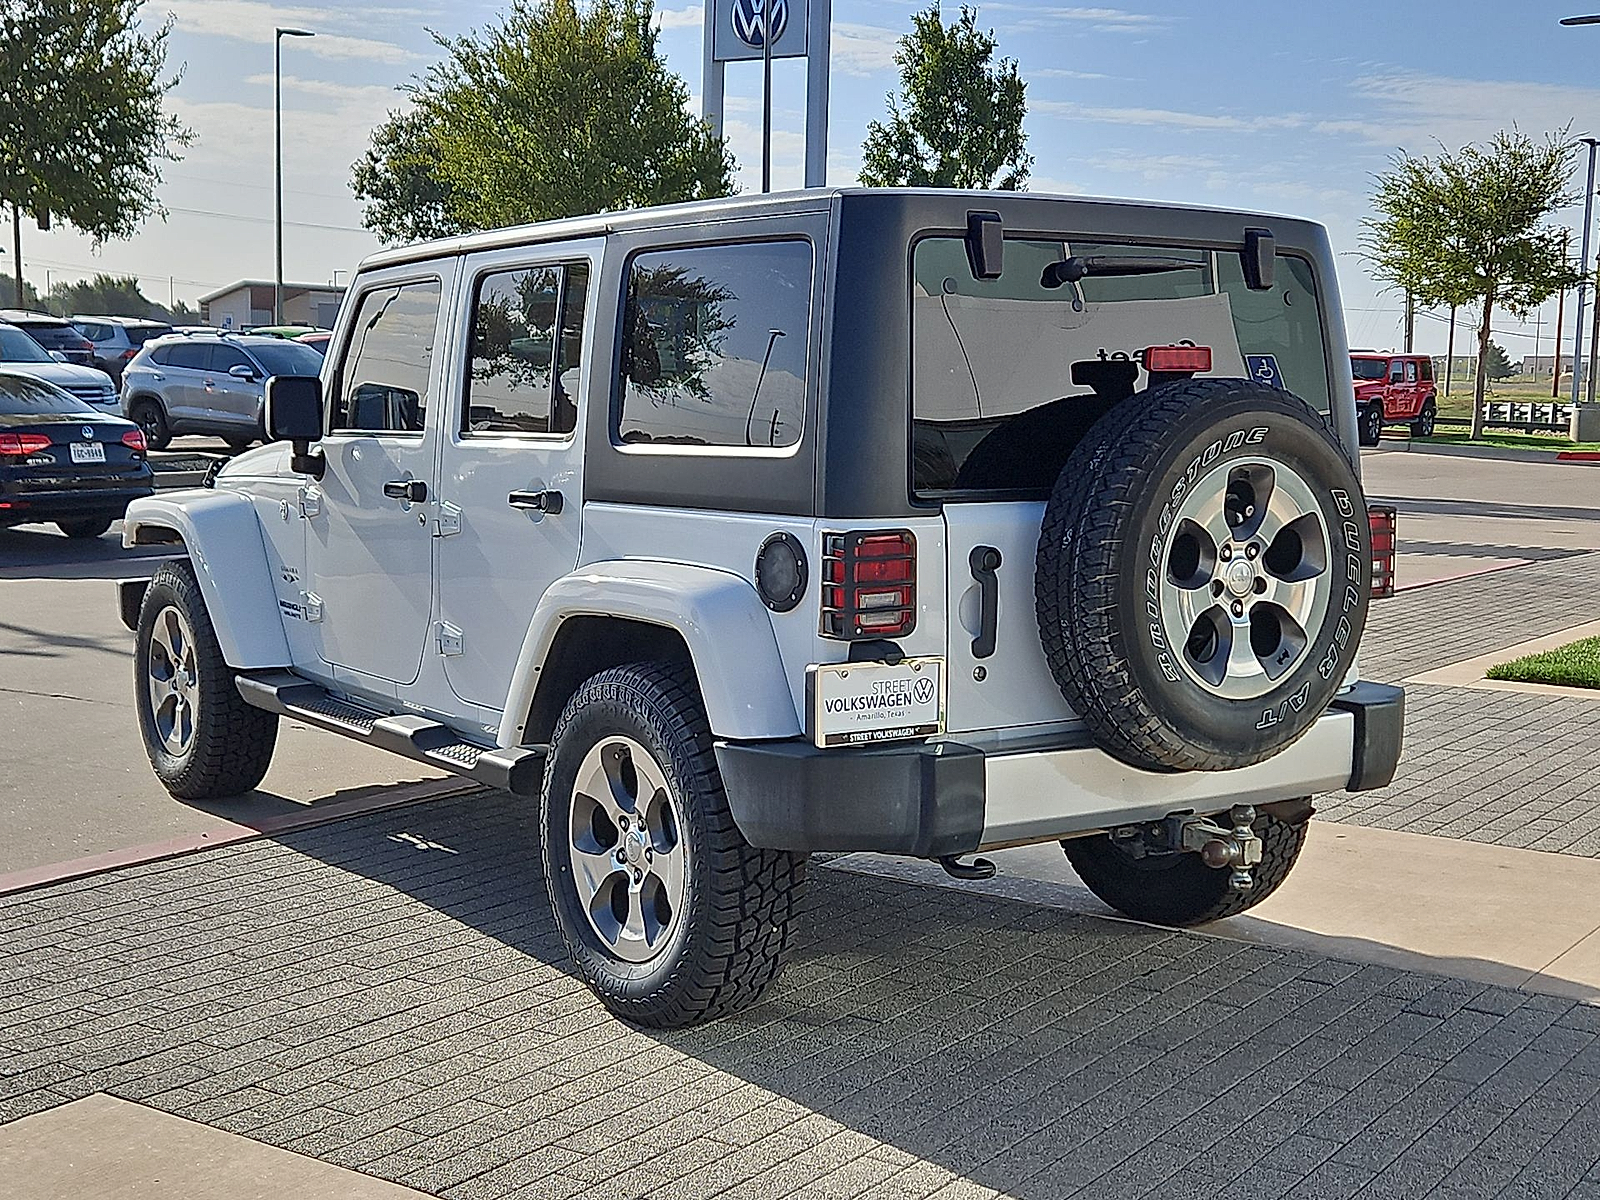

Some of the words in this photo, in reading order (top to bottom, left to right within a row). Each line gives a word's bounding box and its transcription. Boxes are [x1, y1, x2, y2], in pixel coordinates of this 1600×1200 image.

[1146, 427, 1269, 682] BRIDGESTONE
[1317, 488, 1362, 680] DUELER
[872, 679, 912, 695] STREET
[825, 692, 912, 713] VOLKSWAGEN
[1255, 682, 1310, 730] A/T
[856, 712, 886, 721] Amarillo,
[887, 710, 905, 719] Texas
[849, 732, 872, 742] STREET
[873, 727, 915, 739] VOLKSWAGEN
